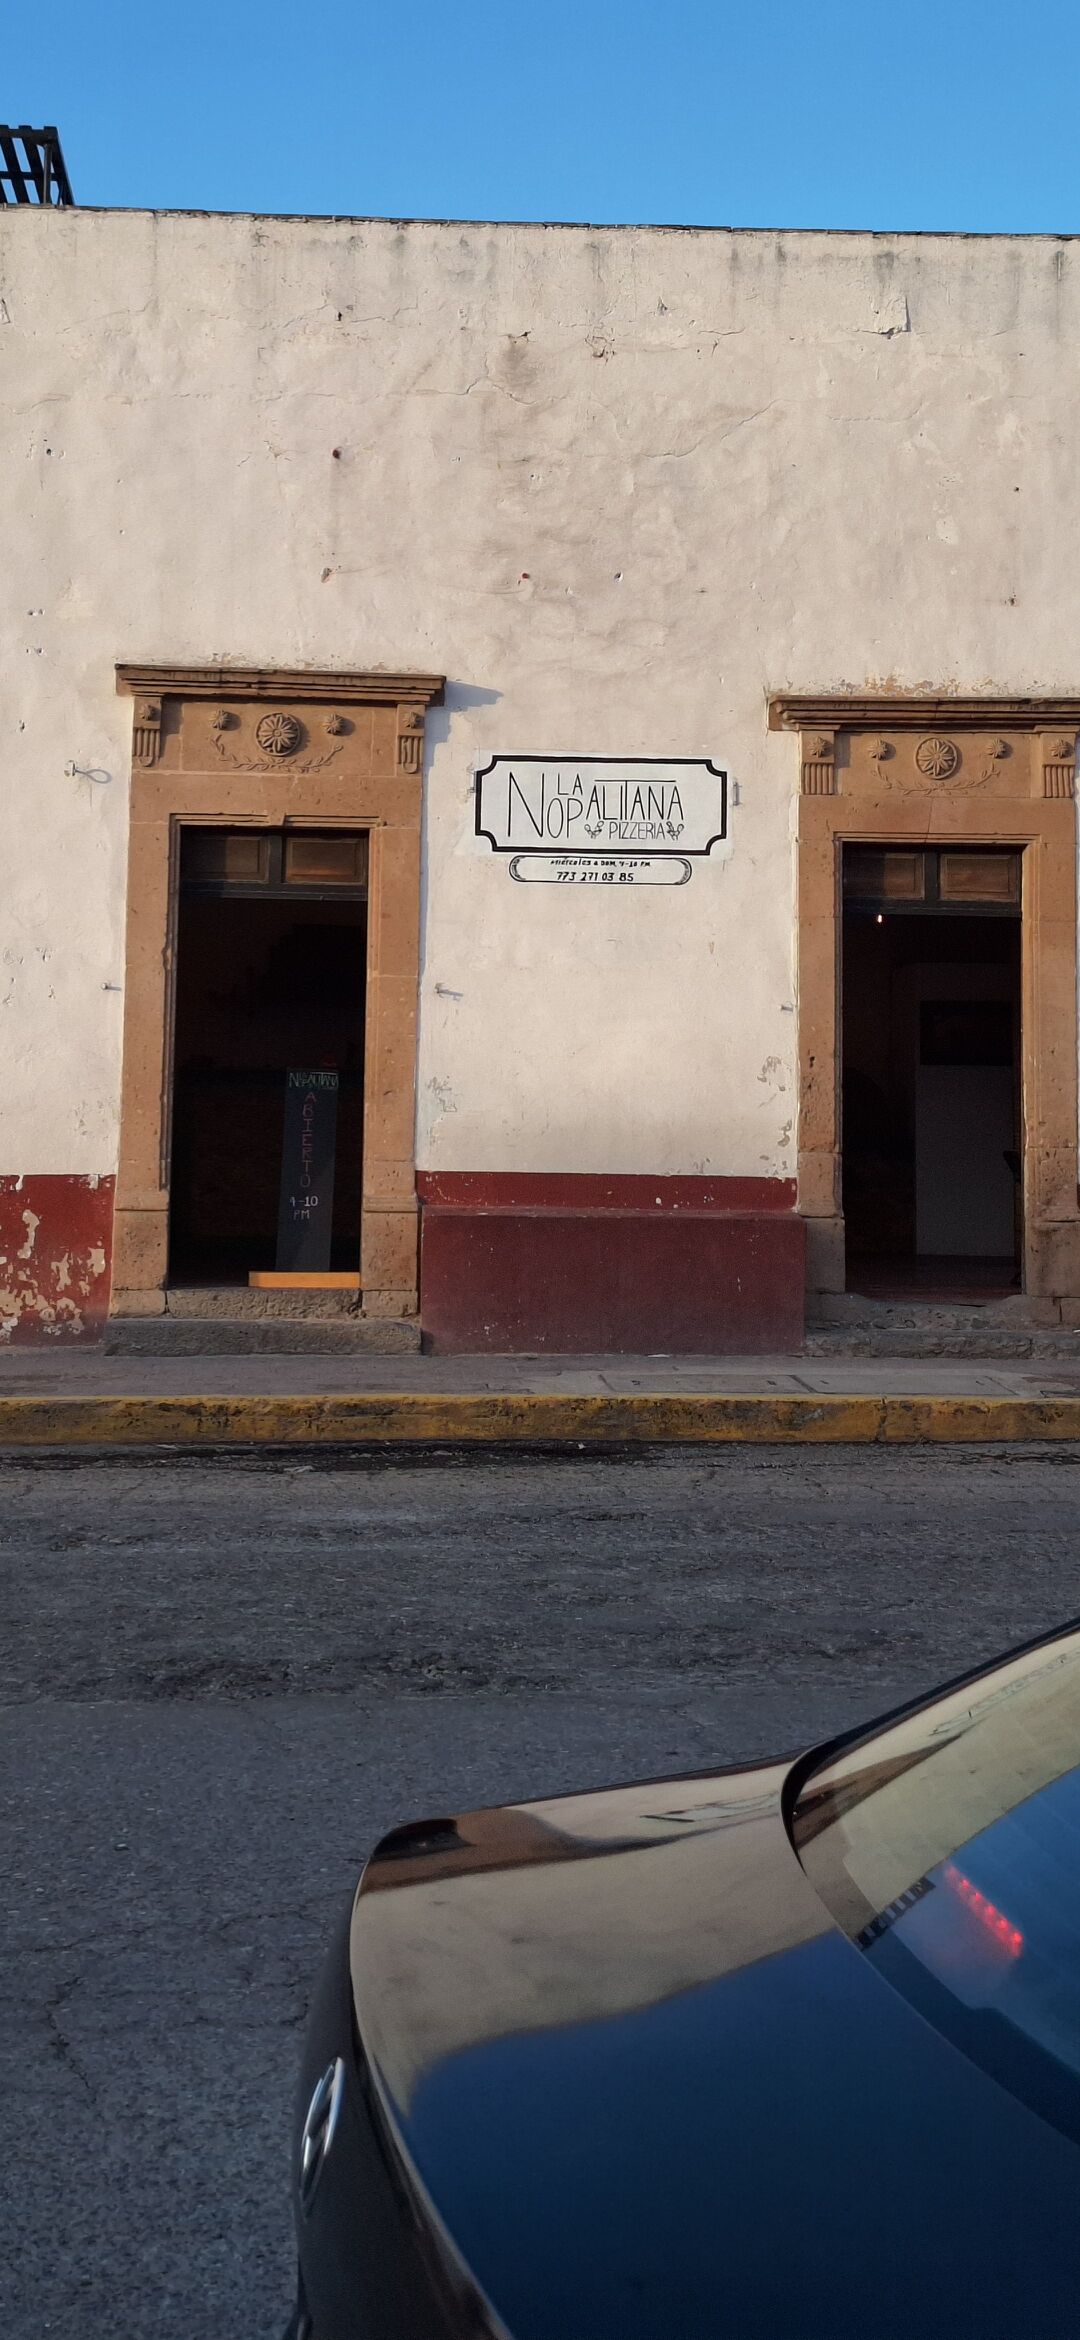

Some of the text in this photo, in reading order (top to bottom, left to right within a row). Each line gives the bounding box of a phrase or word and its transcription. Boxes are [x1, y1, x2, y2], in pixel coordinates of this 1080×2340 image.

[557, 773, 584, 796] LA
[507, 771, 685, 839] NOPALITANA
[608, 821, 667, 840] PIZZERIA
[556, 871, 635, 882] 773 271 03 85
[299, 1091, 318, 1189] ABIERTO
[292, 1209, 311, 1221] PM
